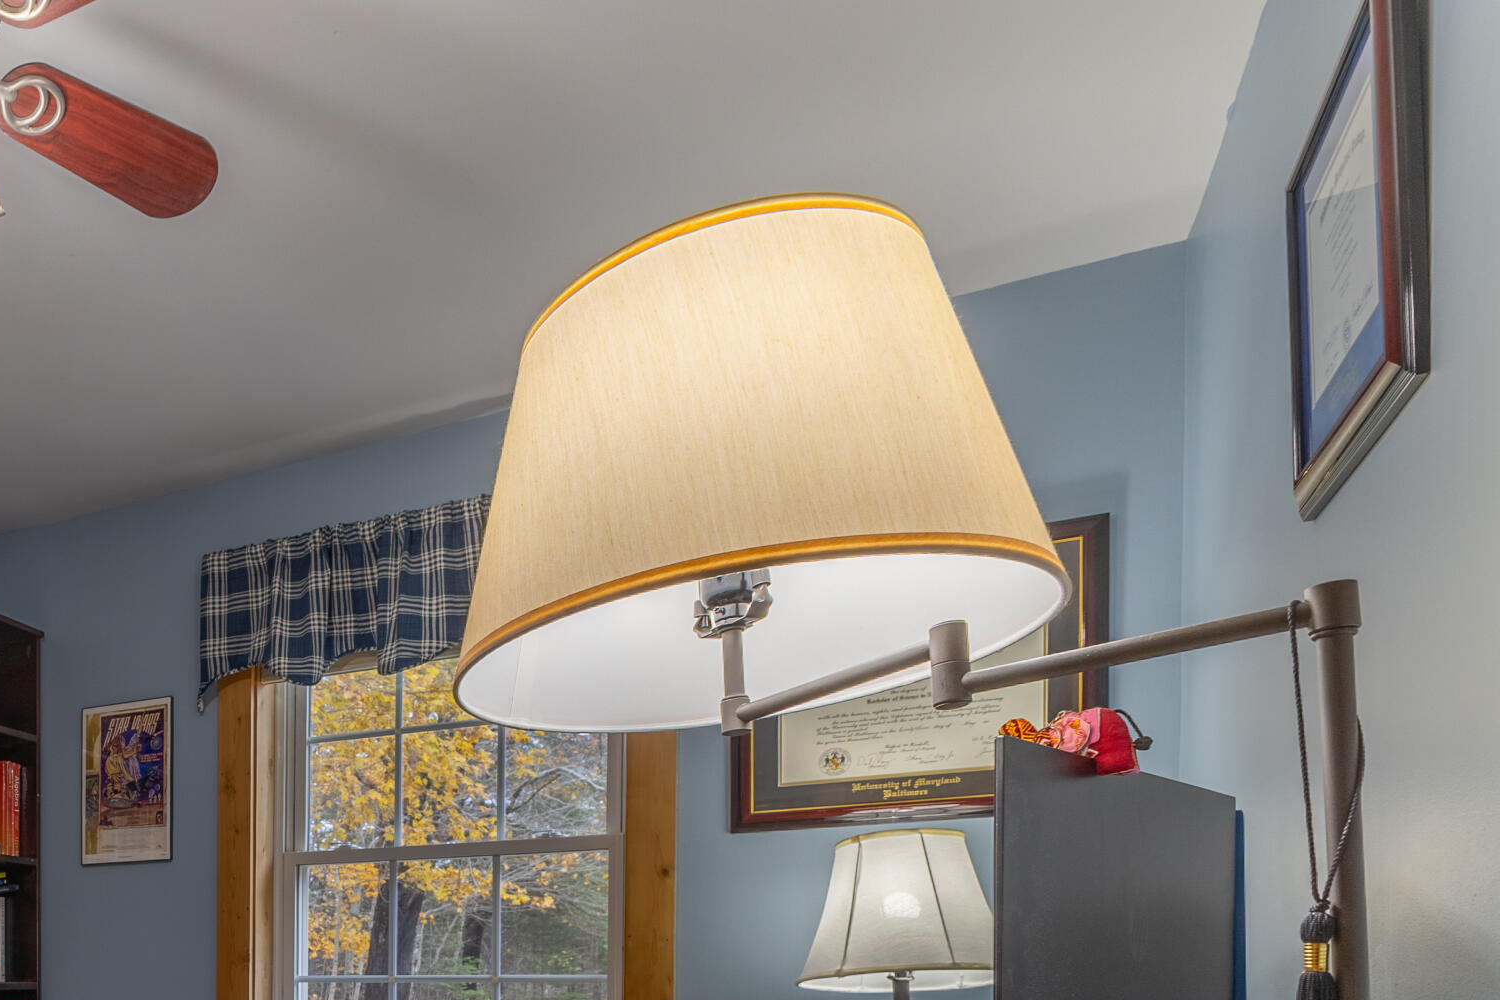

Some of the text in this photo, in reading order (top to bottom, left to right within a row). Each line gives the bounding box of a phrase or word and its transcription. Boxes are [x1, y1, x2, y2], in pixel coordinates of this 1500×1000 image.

[104, 713, 160, 749] STAR WARS
[852, 776, 961, 793] University of Maryland
[883, 789, 929, 799] Baltimore
